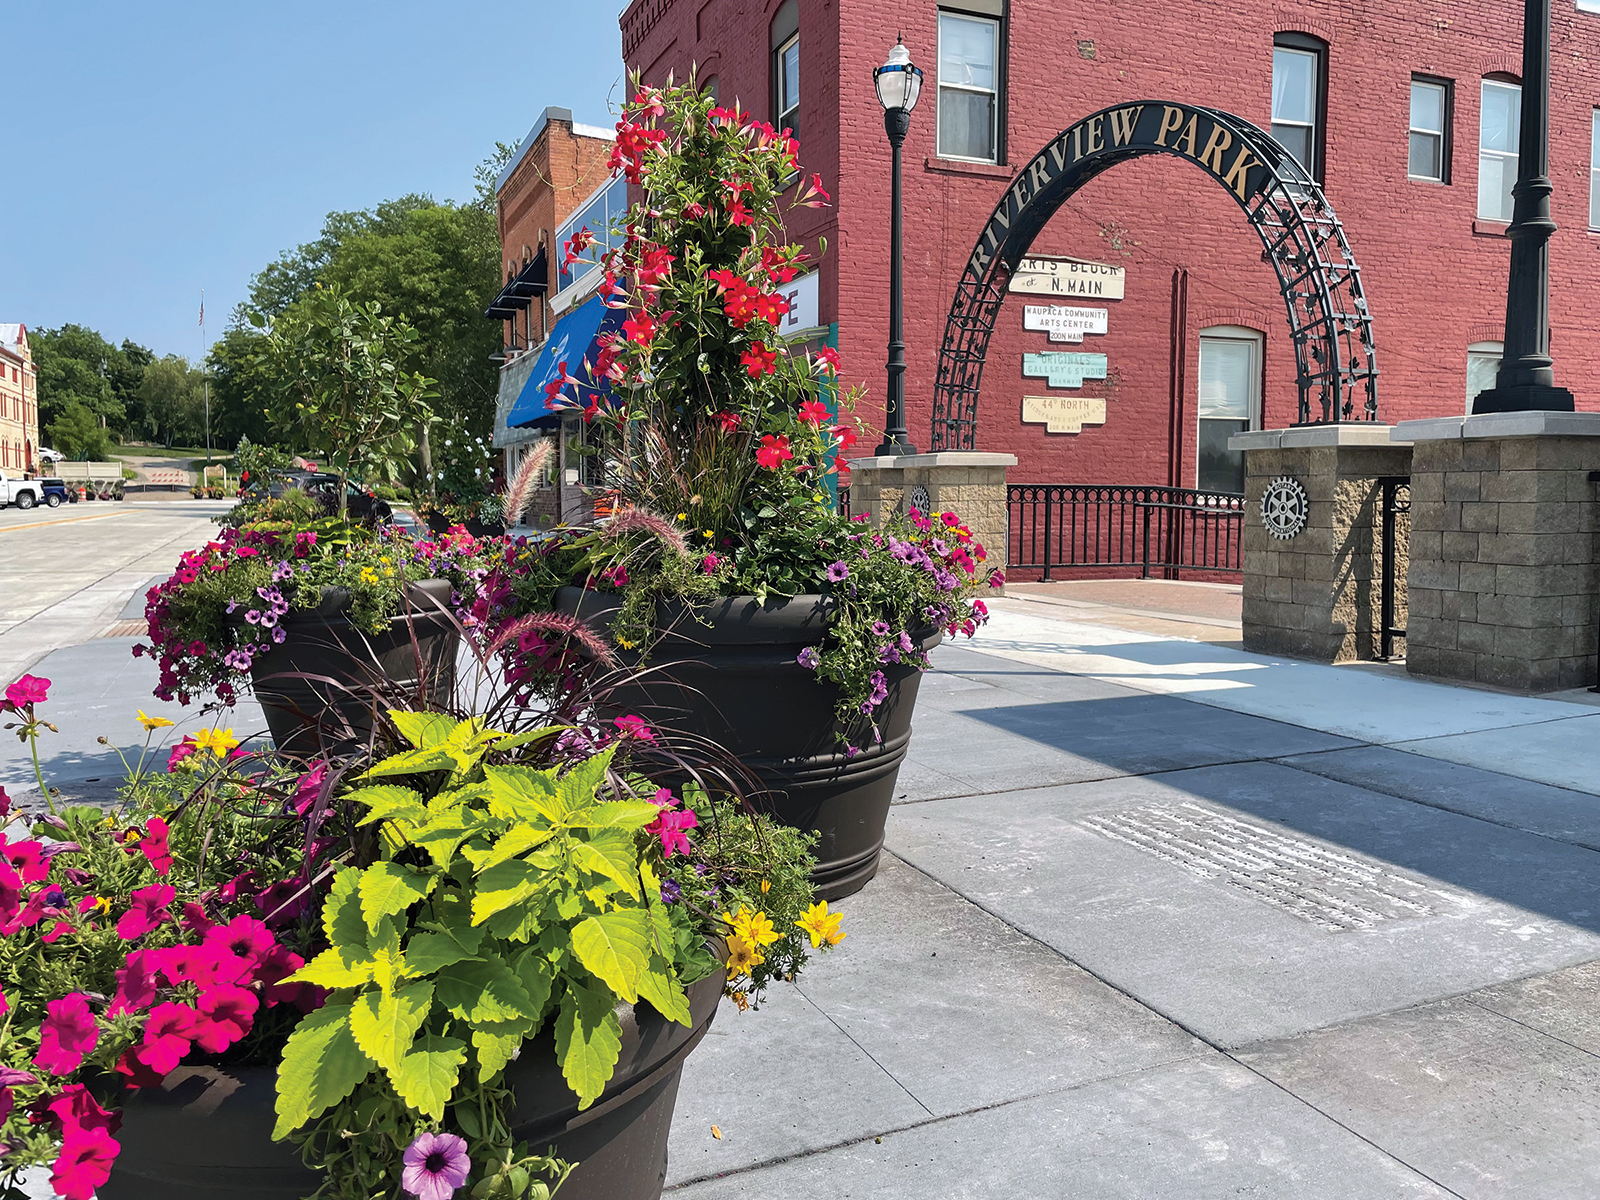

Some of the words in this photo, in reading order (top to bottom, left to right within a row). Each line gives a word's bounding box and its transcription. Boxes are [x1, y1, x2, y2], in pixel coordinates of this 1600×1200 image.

[970, 105, 1145, 279] RIVERVIEW
[1153, 105, 1265, 202] PARK
[782, 289, 799, 326] E
[1026, 306, 1063, 317] WAUPACA
[1064, 307, 1107, 319] COMMUNITY
[1039, 318, 1061, 327] ARTS
[1062, 320, 1094, 329] CENTER
[1041, 355, 1091, 365] ORIGINALS
[1027, 365, 1066, 373] GALLERY
[1060, 400, 1090, 410] NORTH
